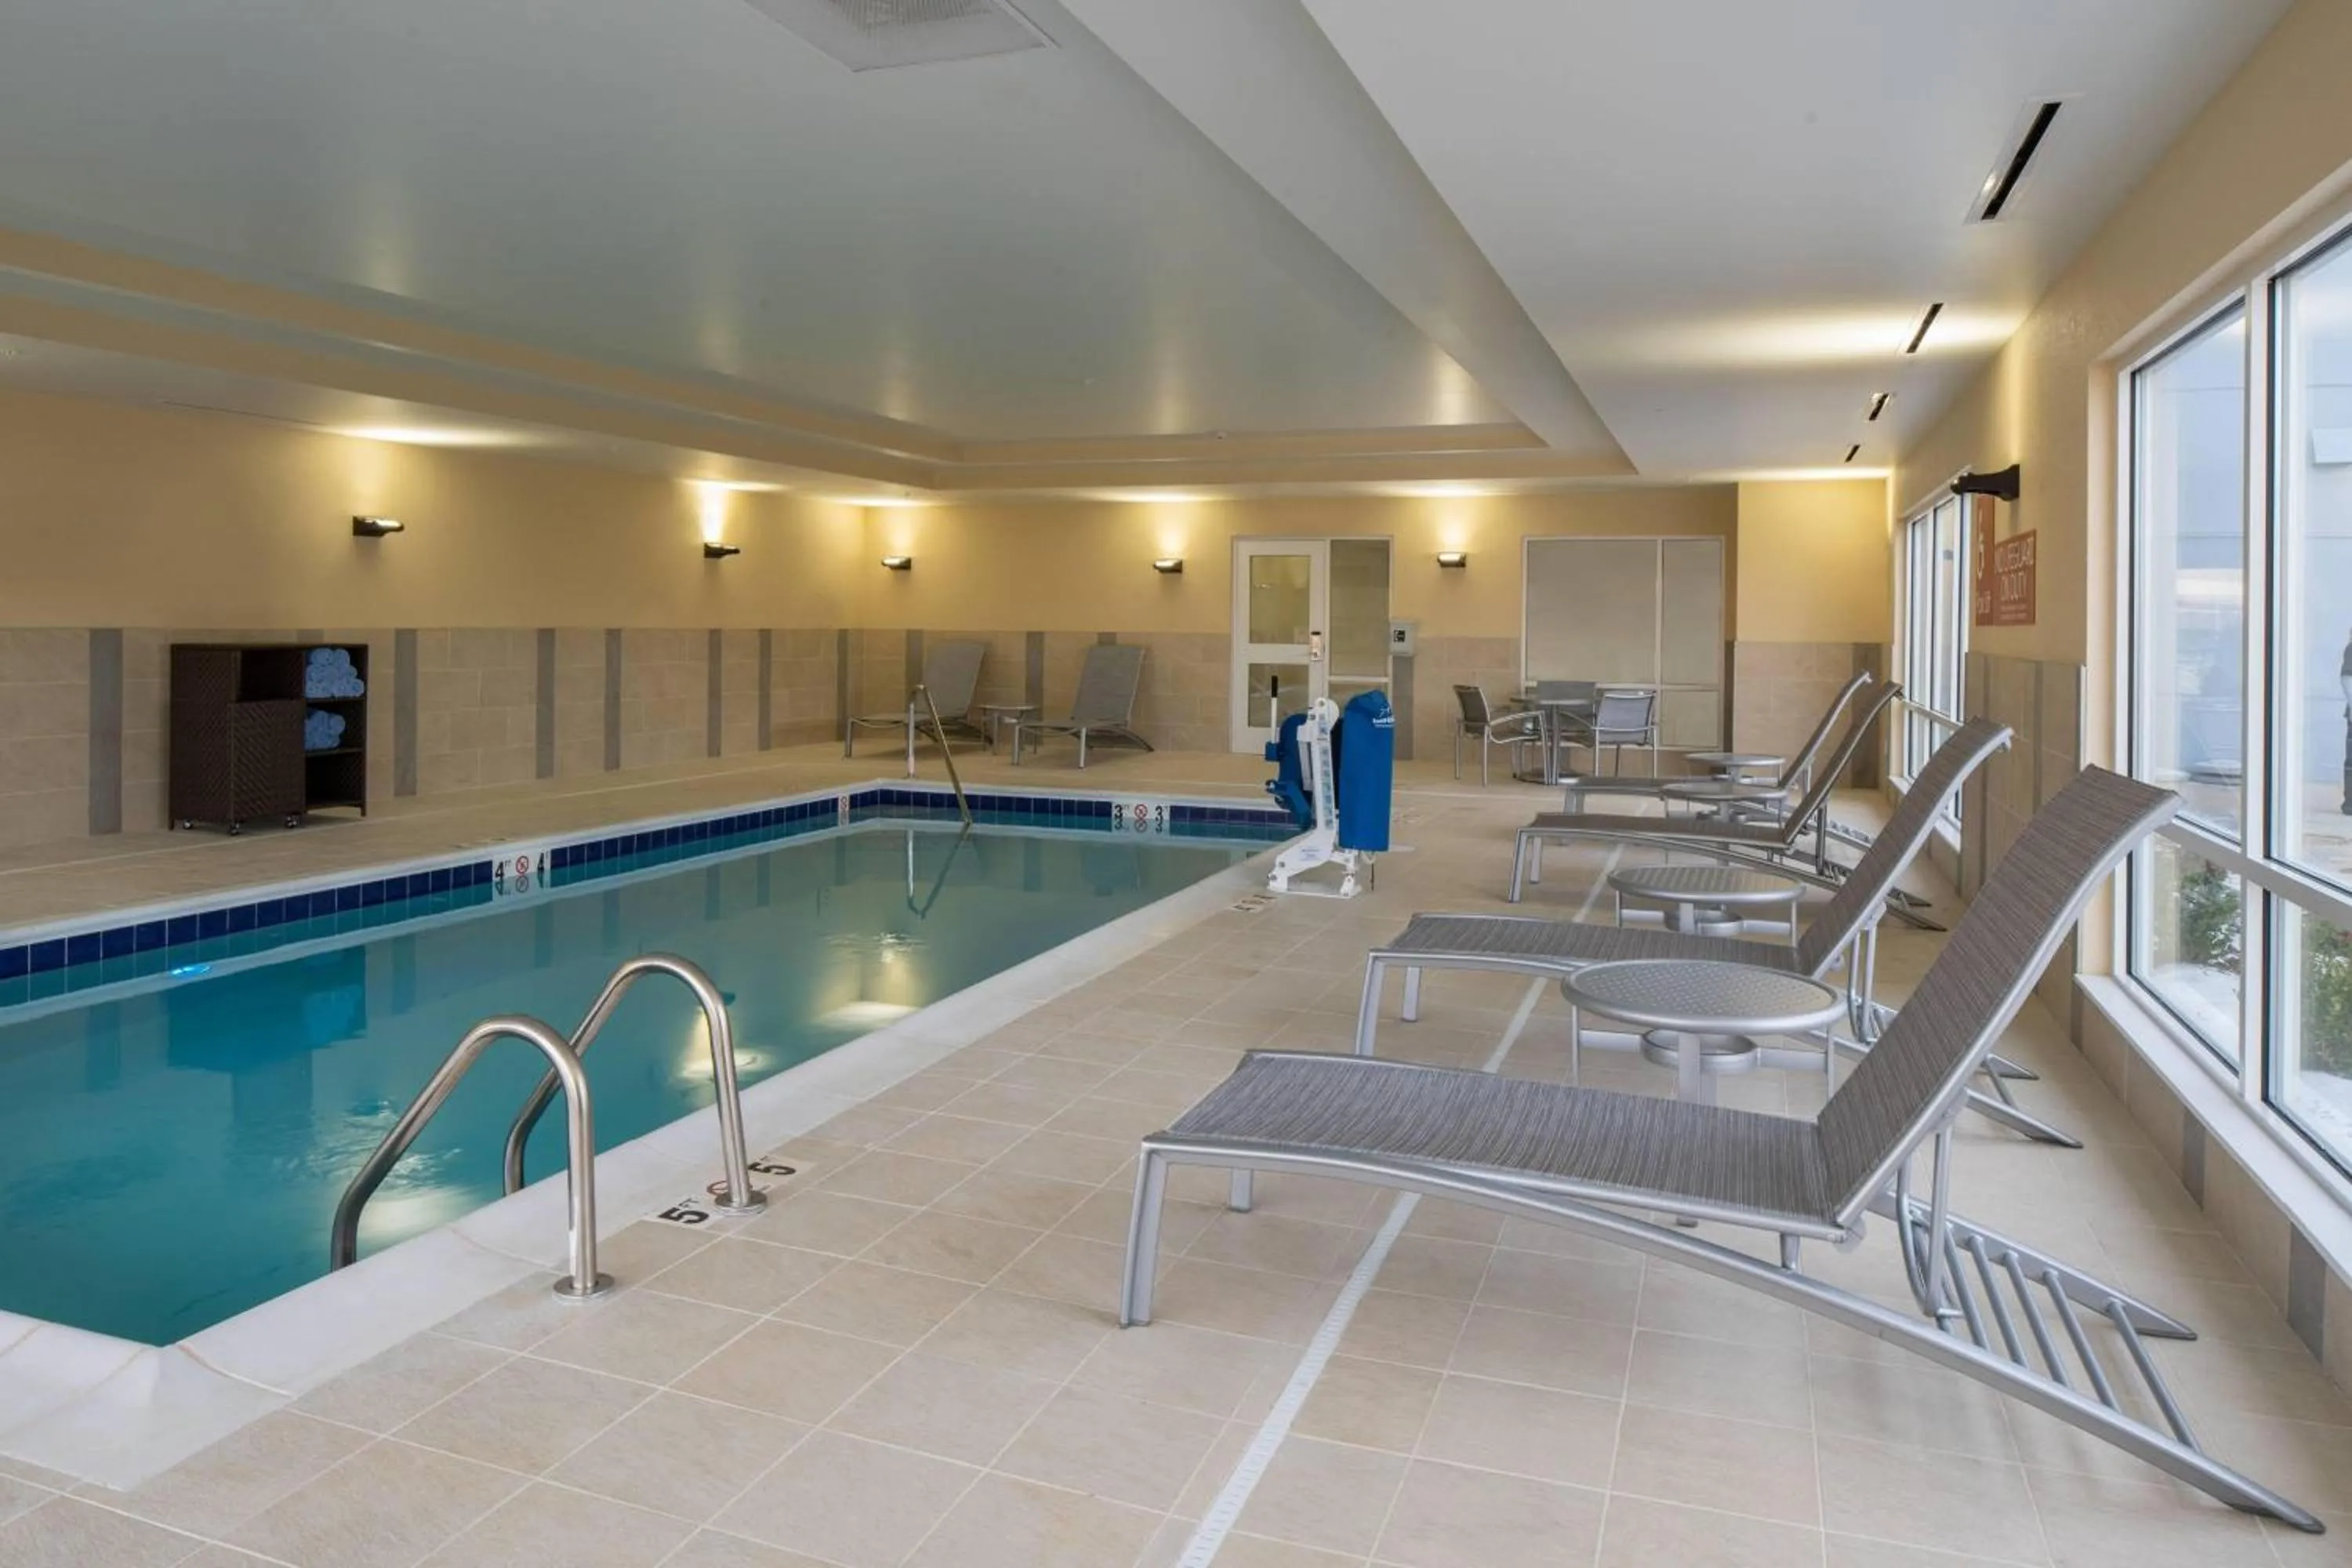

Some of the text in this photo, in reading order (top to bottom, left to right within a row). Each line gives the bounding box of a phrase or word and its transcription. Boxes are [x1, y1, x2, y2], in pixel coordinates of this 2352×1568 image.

[1114, 804, 1123, 818] 3
[1155, 805, 1163, 821] 3
[495, 862, 504, 879] 4
[537, 852, 545, 873] 4
[657, 1207, 710, 1224] 5
[747, 1161, 797, 1175] 5
